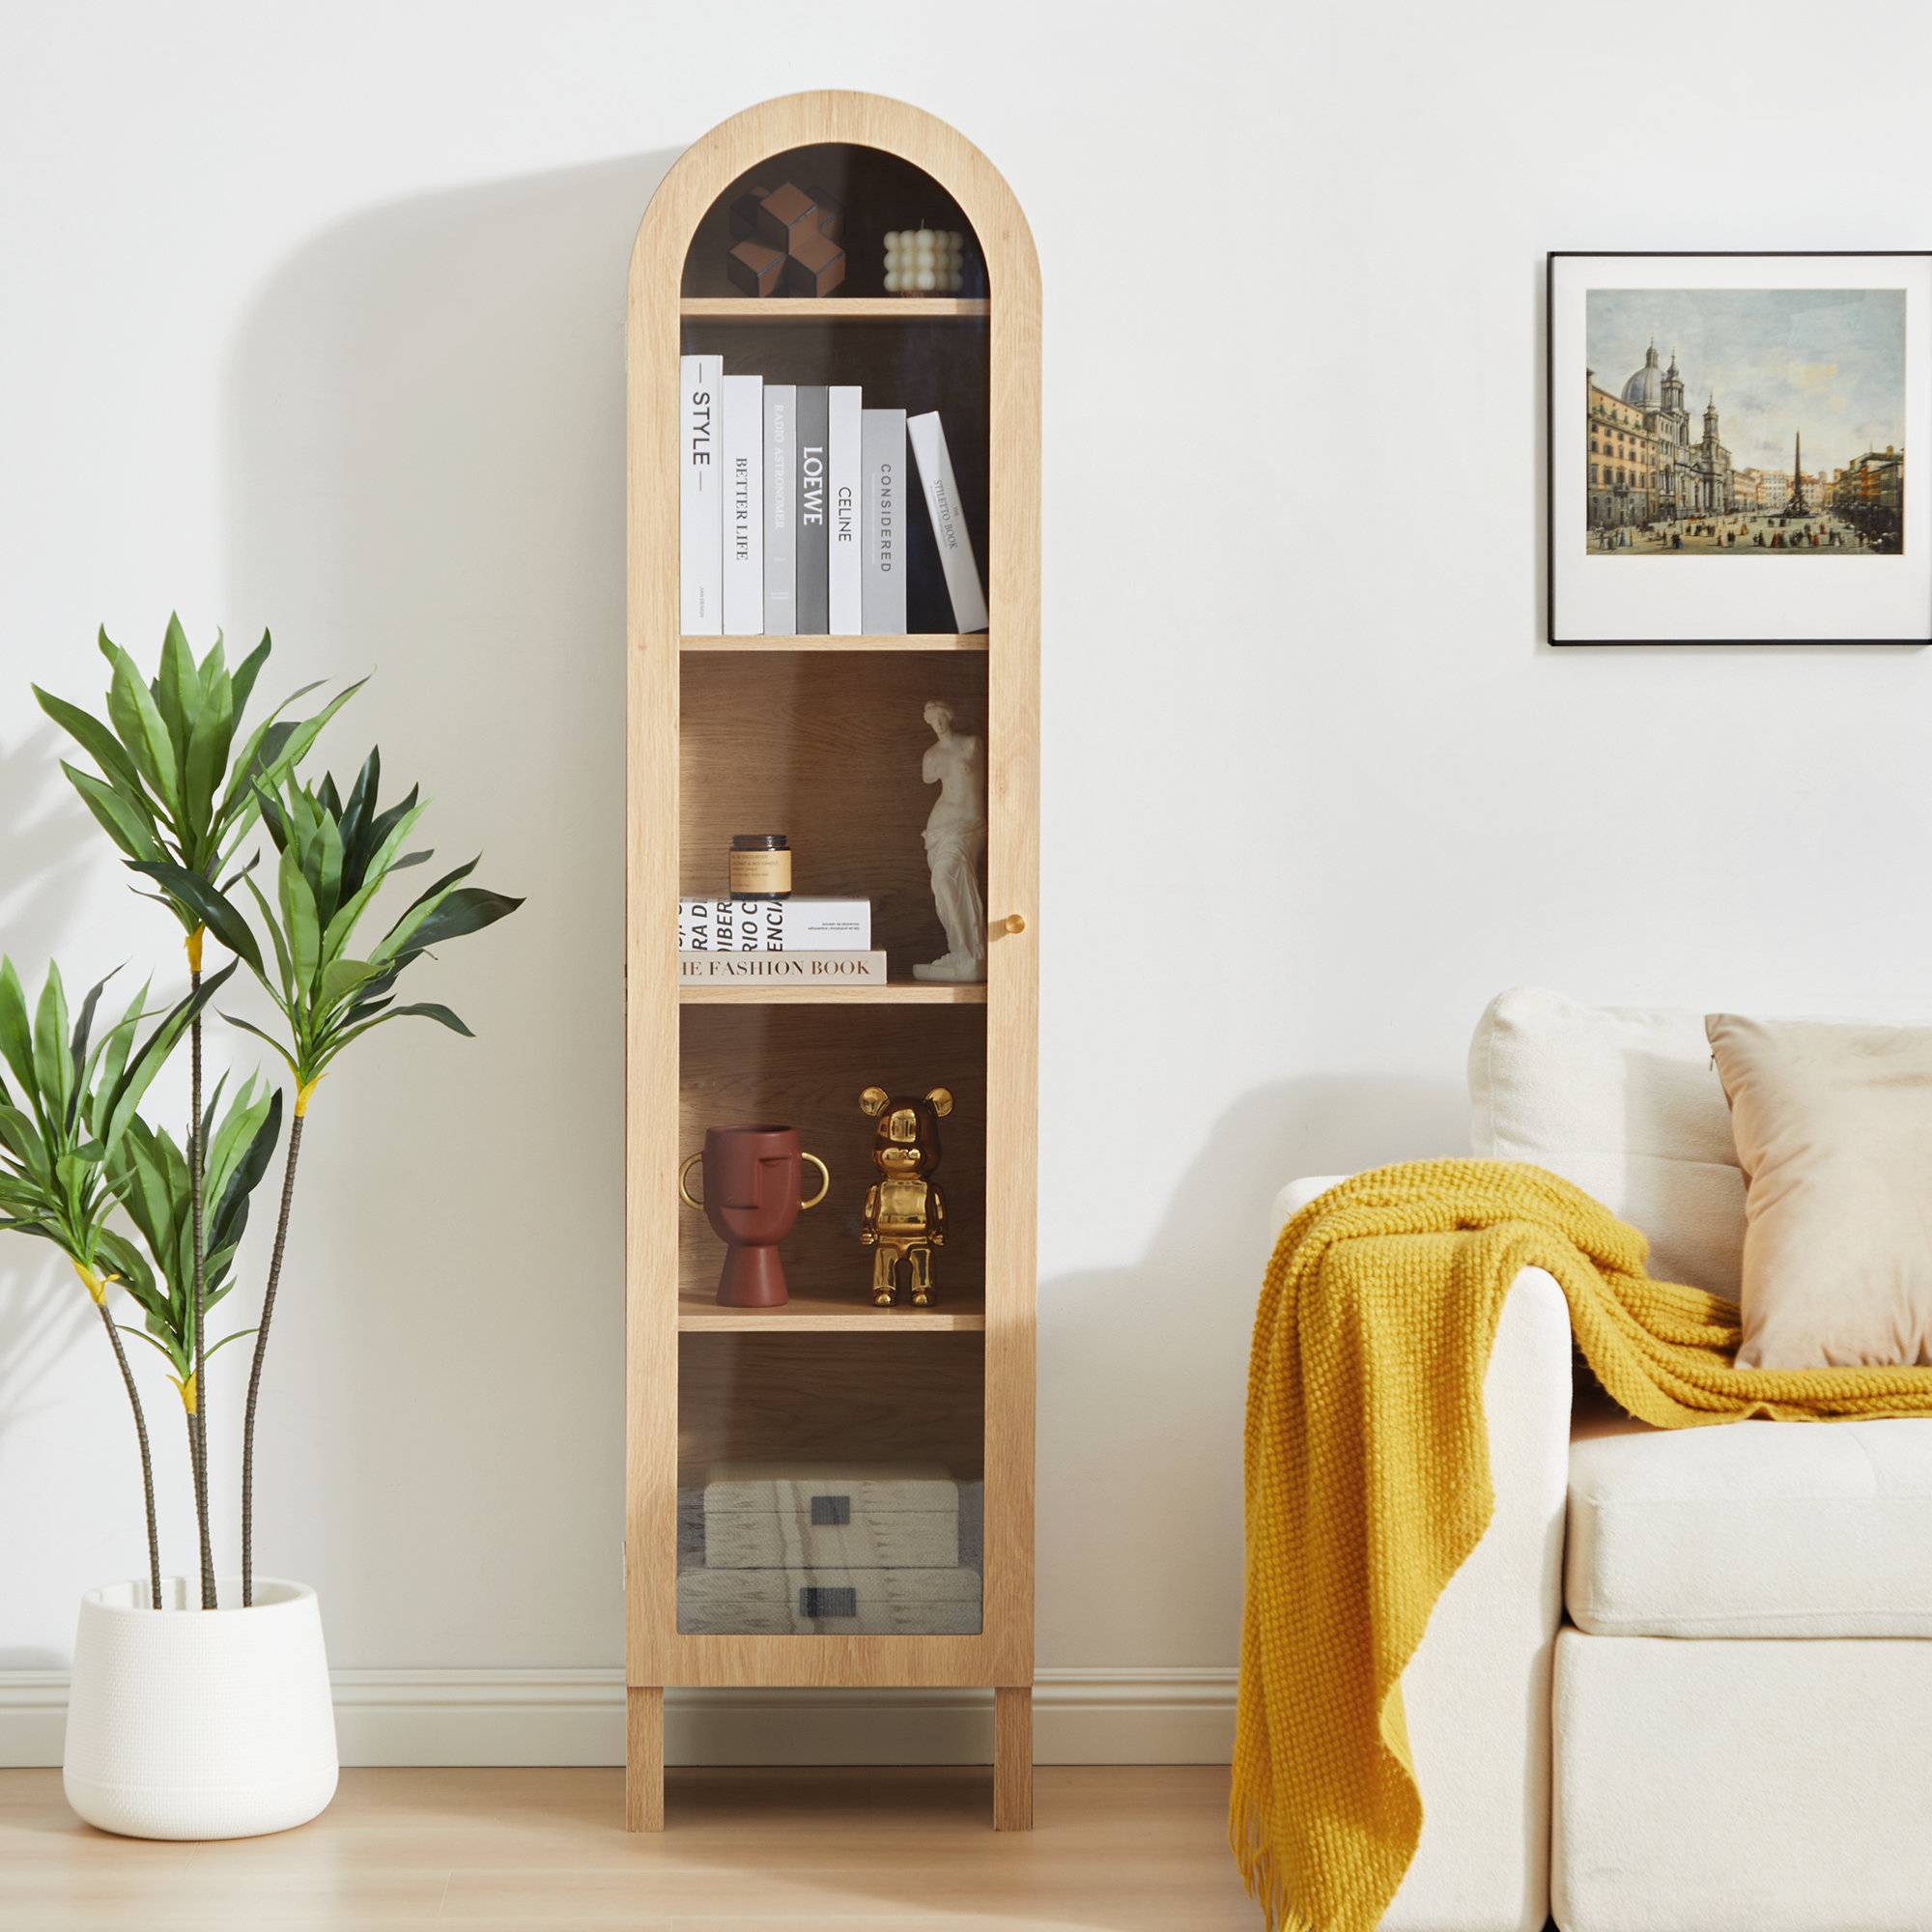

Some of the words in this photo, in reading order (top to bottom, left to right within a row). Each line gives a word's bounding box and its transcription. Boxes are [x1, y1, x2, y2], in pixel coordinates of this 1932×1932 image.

[693, 391, 710, 466] STYLE
[775, 404, 784, 442] RADIO
[735, 458, 748, 520] BETTER
[775, 446, 784, 529] ASTRONOMER
[804, 446, 823, 526] LOEWE
[838, 487, 852, 542] CELINE
[933, 479, 951, 521] STILETTO
[944, 523, 958, 550] BOOK
[735, 522, 748, 560] LIFE
[880, 464, 892, 573] CONSIDERED
[717, 901, 733, 952] IBER
[709, 960, 805, 976] FASHION
[811, 960, 870, 976] BOOK
